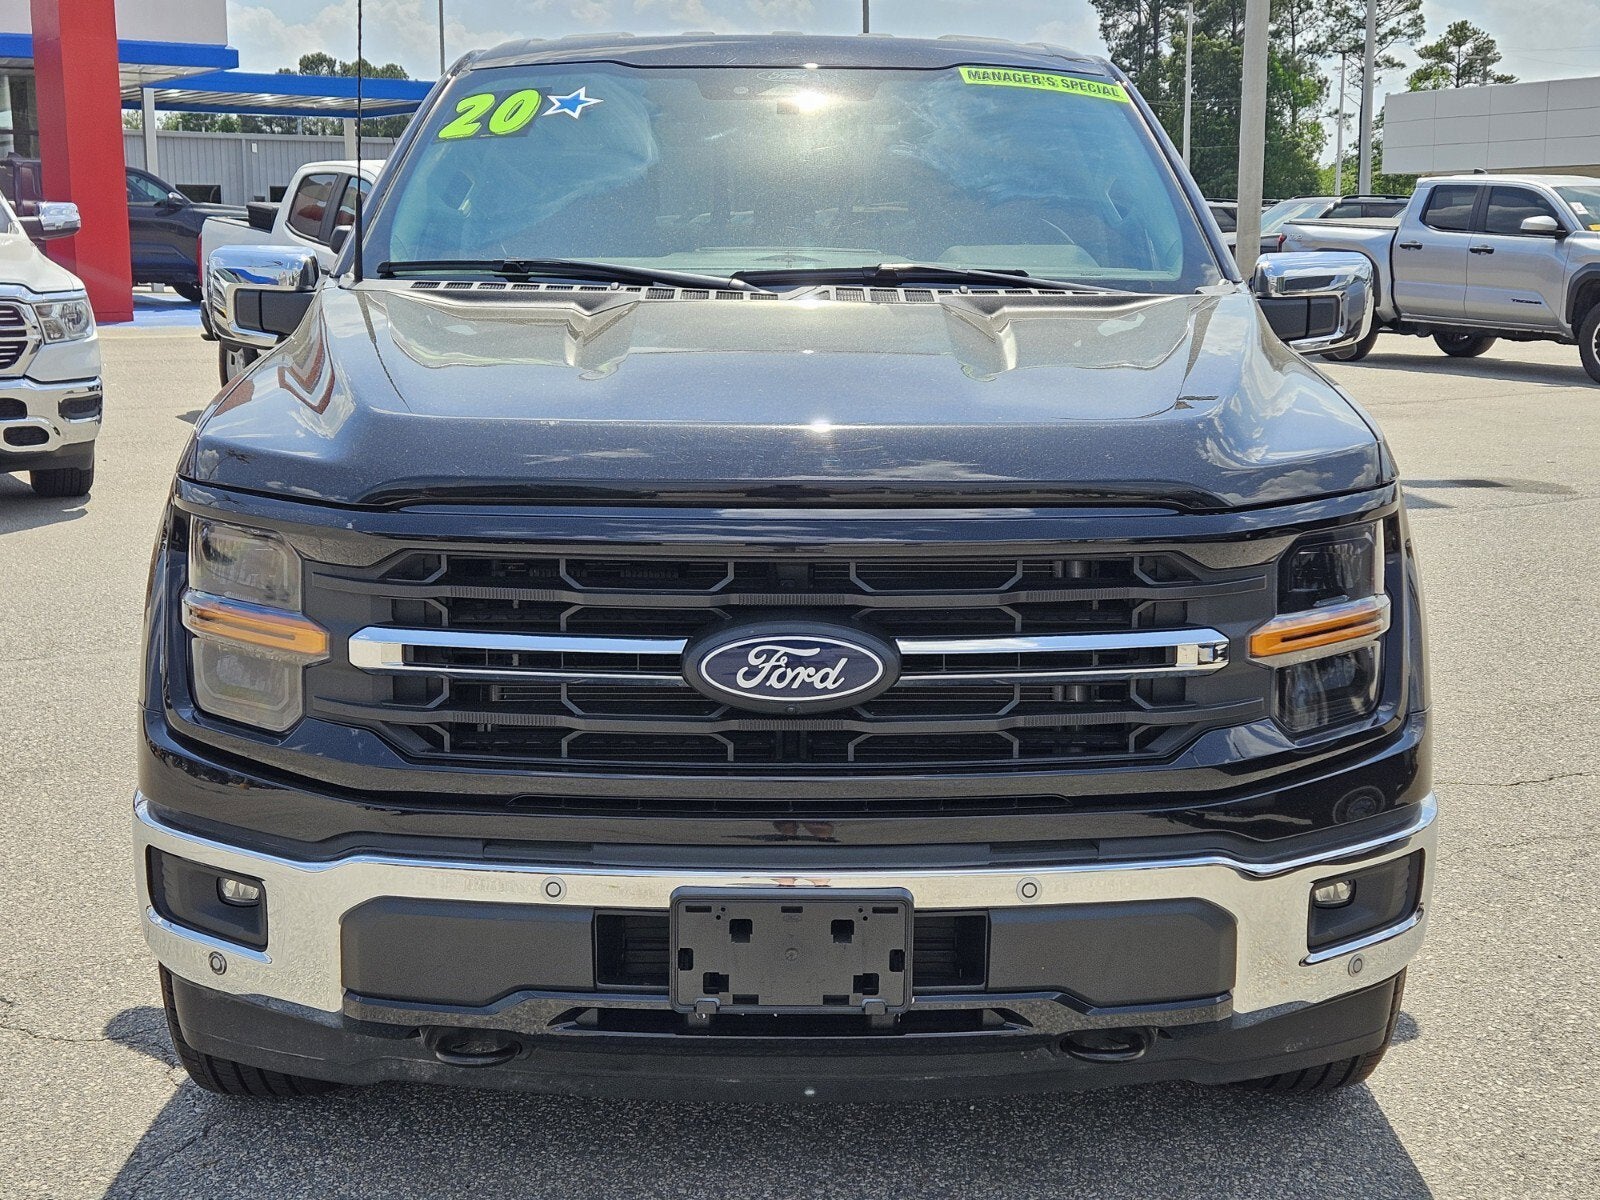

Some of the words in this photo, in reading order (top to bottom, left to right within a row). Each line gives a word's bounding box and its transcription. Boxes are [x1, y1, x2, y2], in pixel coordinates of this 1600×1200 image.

[967, 69, 1056, 87] MANAGER'S
[1061, 78, 1119, 97] SPECIAL
[438, 88, 542, 139] 20
[736, 645, 849, 689] Ford
